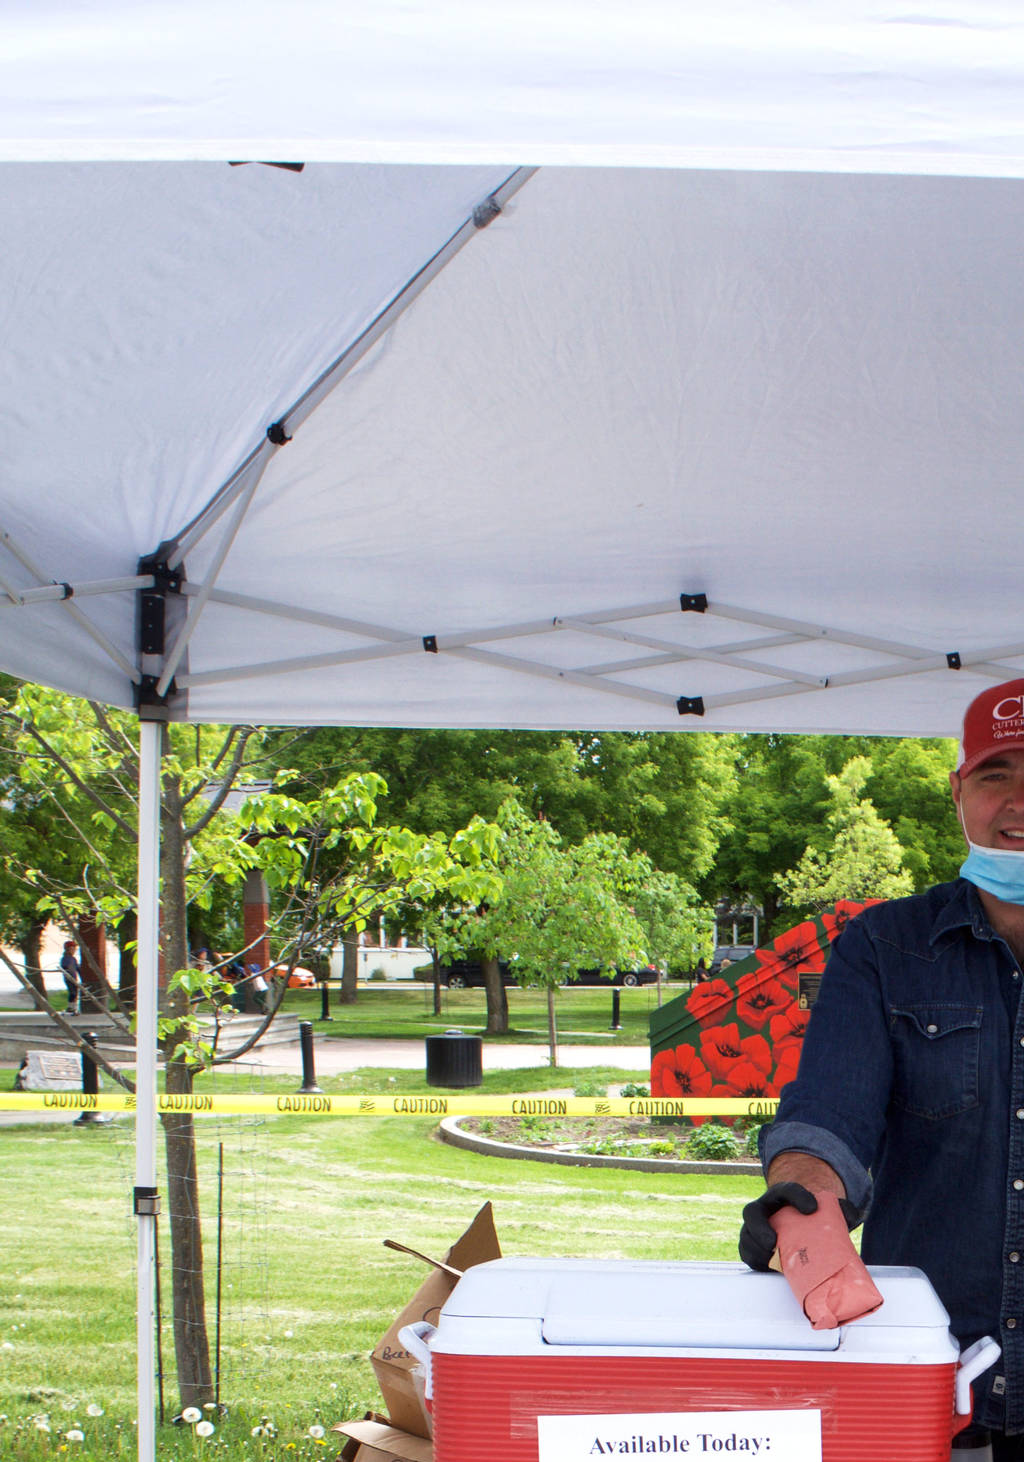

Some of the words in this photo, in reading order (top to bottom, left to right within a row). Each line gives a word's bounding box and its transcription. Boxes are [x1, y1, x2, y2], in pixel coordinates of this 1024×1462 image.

[43, 1095, 98, 1109] CAUTION
[158, 1095, 213, 1111] CAUTION
[276, 1096, 331, 1112] CAUTION
[393, 1098, 448, 1114] CAUTION
[511, 1099, 567, 1115] CAUTION
[629, 1100, 684, 1116] CAUTION
[748, 1102, 780, 1115] CAUT
[589, 1435, 691, 1454] Available
[696, 1433, 772, 1456] Today:
